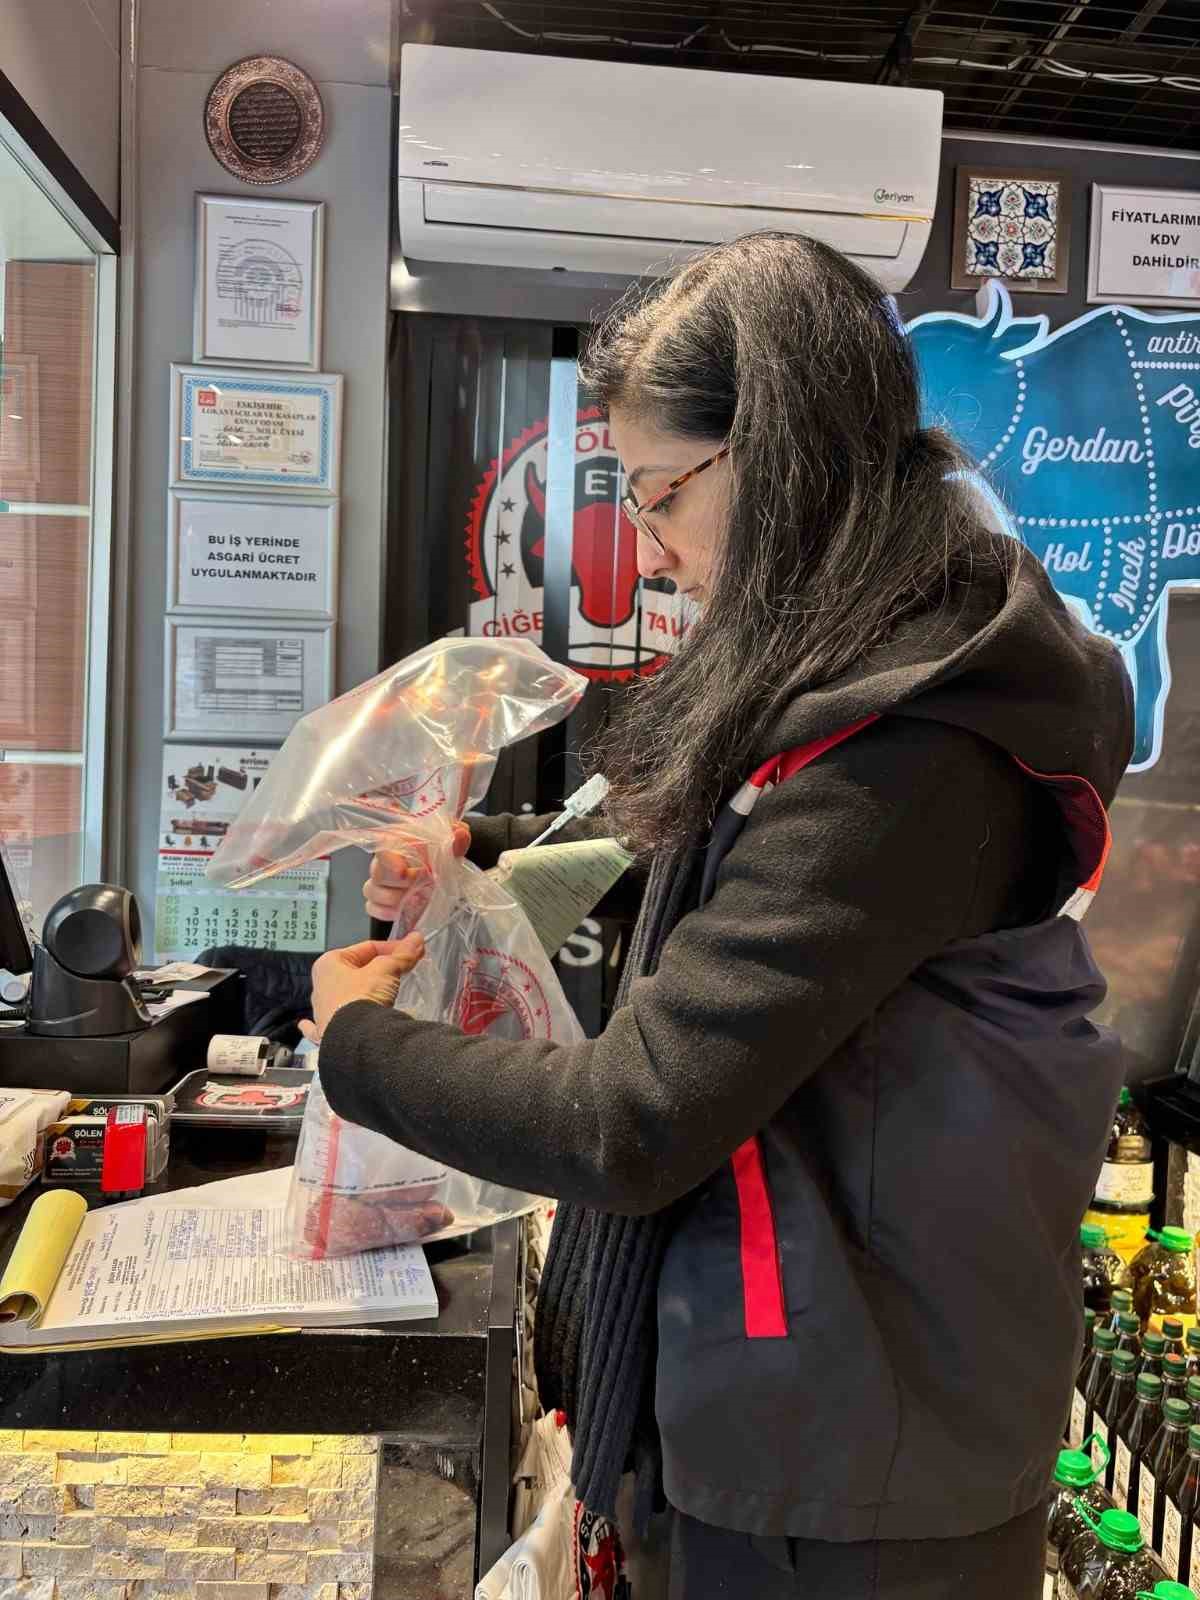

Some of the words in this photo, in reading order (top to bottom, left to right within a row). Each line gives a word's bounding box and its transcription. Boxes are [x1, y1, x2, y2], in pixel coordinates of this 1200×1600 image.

[1150, 233, 1180, 245] KDV
[1132, 254, 1200, 269] DAHİLDİR
[1021, 426, 1145, 475] Gerdan
[208, 535, 225, 545] BU
[229, 534, 241, 547] İŞ
[245, 535, 300, 548] YERİNDE
[207, 551, 254, 563] ASGARİ
[258, 551, 300, 564] ÜCRET
[191, 567, 317, 582] UYGULANMAKTADIR
[646, 611, 689, 637] TAV
[292, 900, 297, 909] 1
[311, 900, 318, 909] 2
[192, 906, 199, 916] 3
[212, 907, 219, 916] 4
[231, 908, 239, 917] 5
[252, 908, 258, 918] 6
[272, 910, 278, 919] 7
[291, 910, 298, 919] 8
[311, 911, 318, 920] 9
[185, 917, 199, 926] 10
[205, 918, 218, 927] 11
[225, 918, 239, 928] 12
[244, 919, 258, 928] 13
[264, 919, 278, 929] 14
[284, 920, 297, 929] 15
[304, 921, 318, 930] 16
[185, 927, 198, 936] 17
[205, 928, 218, 937] 18
[225, 929, 239, 938] 19
[244, 929, 258, 938] 20
[264, 930, 276, 939] 21
[283, 931, 296, 940] 22
[303, 931, 316, 940] 23
[184, 938, 198, 947] 24
